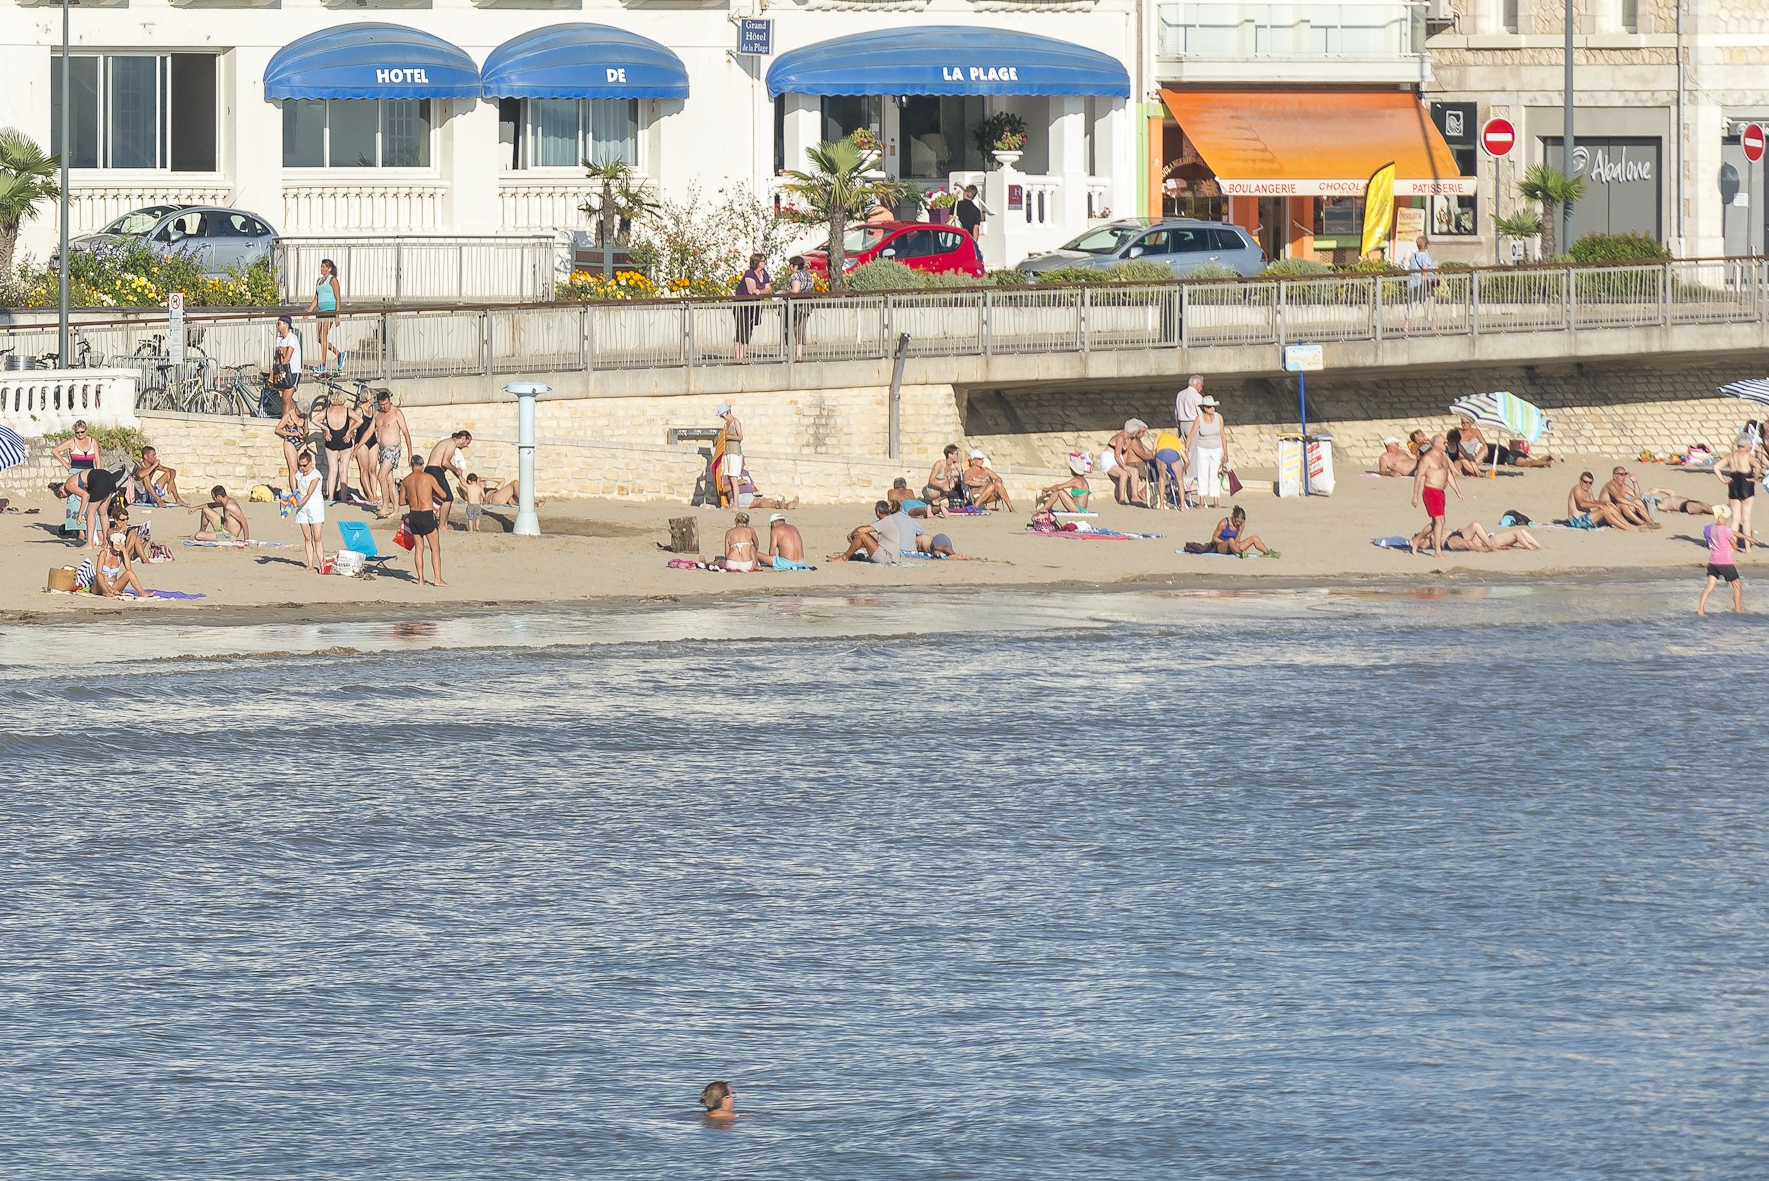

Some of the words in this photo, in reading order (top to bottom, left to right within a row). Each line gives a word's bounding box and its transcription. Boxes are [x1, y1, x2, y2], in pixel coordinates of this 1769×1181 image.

[745, 20, 767, 30] Grand
[745, 31, 767, 41] Hôtel
[742, 43, 748, 52] de
[754, 43, 769, 54] Plage
[376, 68, 429, 85] HOTEL
[606, 68, 627, 83] DE
[942, 67, 963, 81] LA
[970, 67, 1019, 82] PLAGE
[1590, 145, 1651, 184] Abalone
[1228, 183, 1297, 194] BOULANGERIE
[1412, 183, 1464, 194] PATISSERIE
